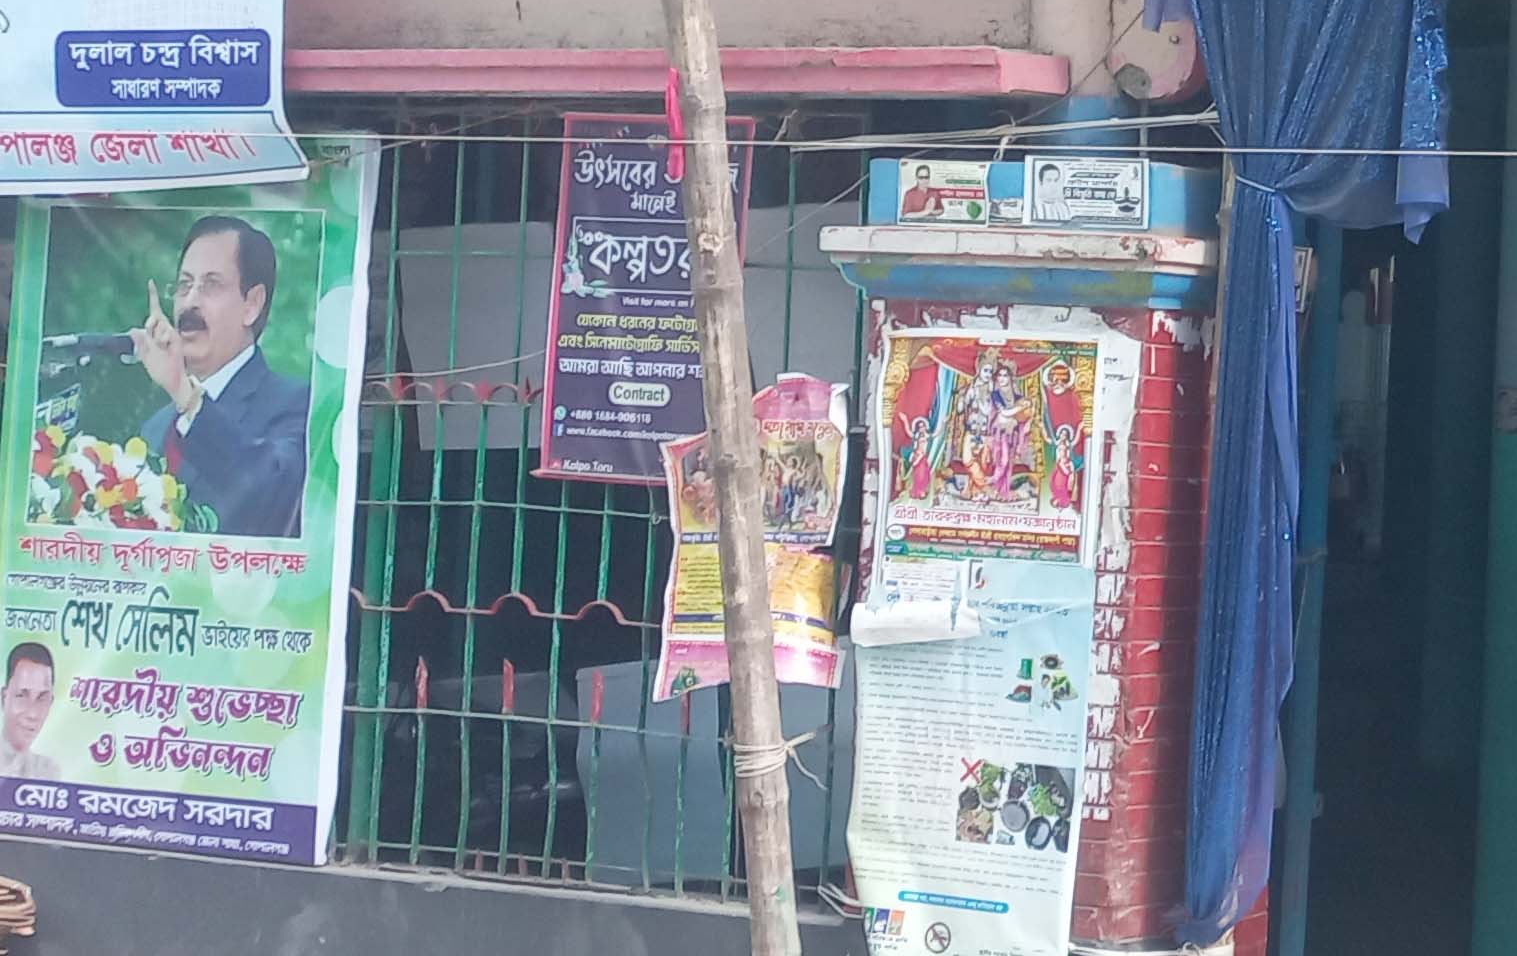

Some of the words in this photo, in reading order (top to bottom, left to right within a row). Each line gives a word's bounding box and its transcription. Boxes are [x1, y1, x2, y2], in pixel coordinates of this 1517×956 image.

[68, 41, 136, 71] দুলাল
[139, 41, 187, 68] চন্দ্র
[189, 33, 261, 66] বিশ্বাস
[112, 78, 162, 100] সাধারণ
[164, 78, 223, 100] সম্পাদক
[90, 130, 162, 165] জেলা
[574, 150, 658, 191] উৎসবের
[558, 358, 600, 375] আমরা
[601, 356, 634, 377] আছি
[613, 384, 666, 403] Contract
[20, 531, 104, 565] শারদীয়
[60, 598, 113, 649] শেখ
[115, 585, 200, 657] সেলিম
[70, 668, 181, 721] শারদীয়
[186, 685, 304, 729] শুভেচ্ছা
[89, 732, 116, 766] ও
[123, 726, 276, 781] অভিনন্দন
[183, 799, 275, 831] সরদার
